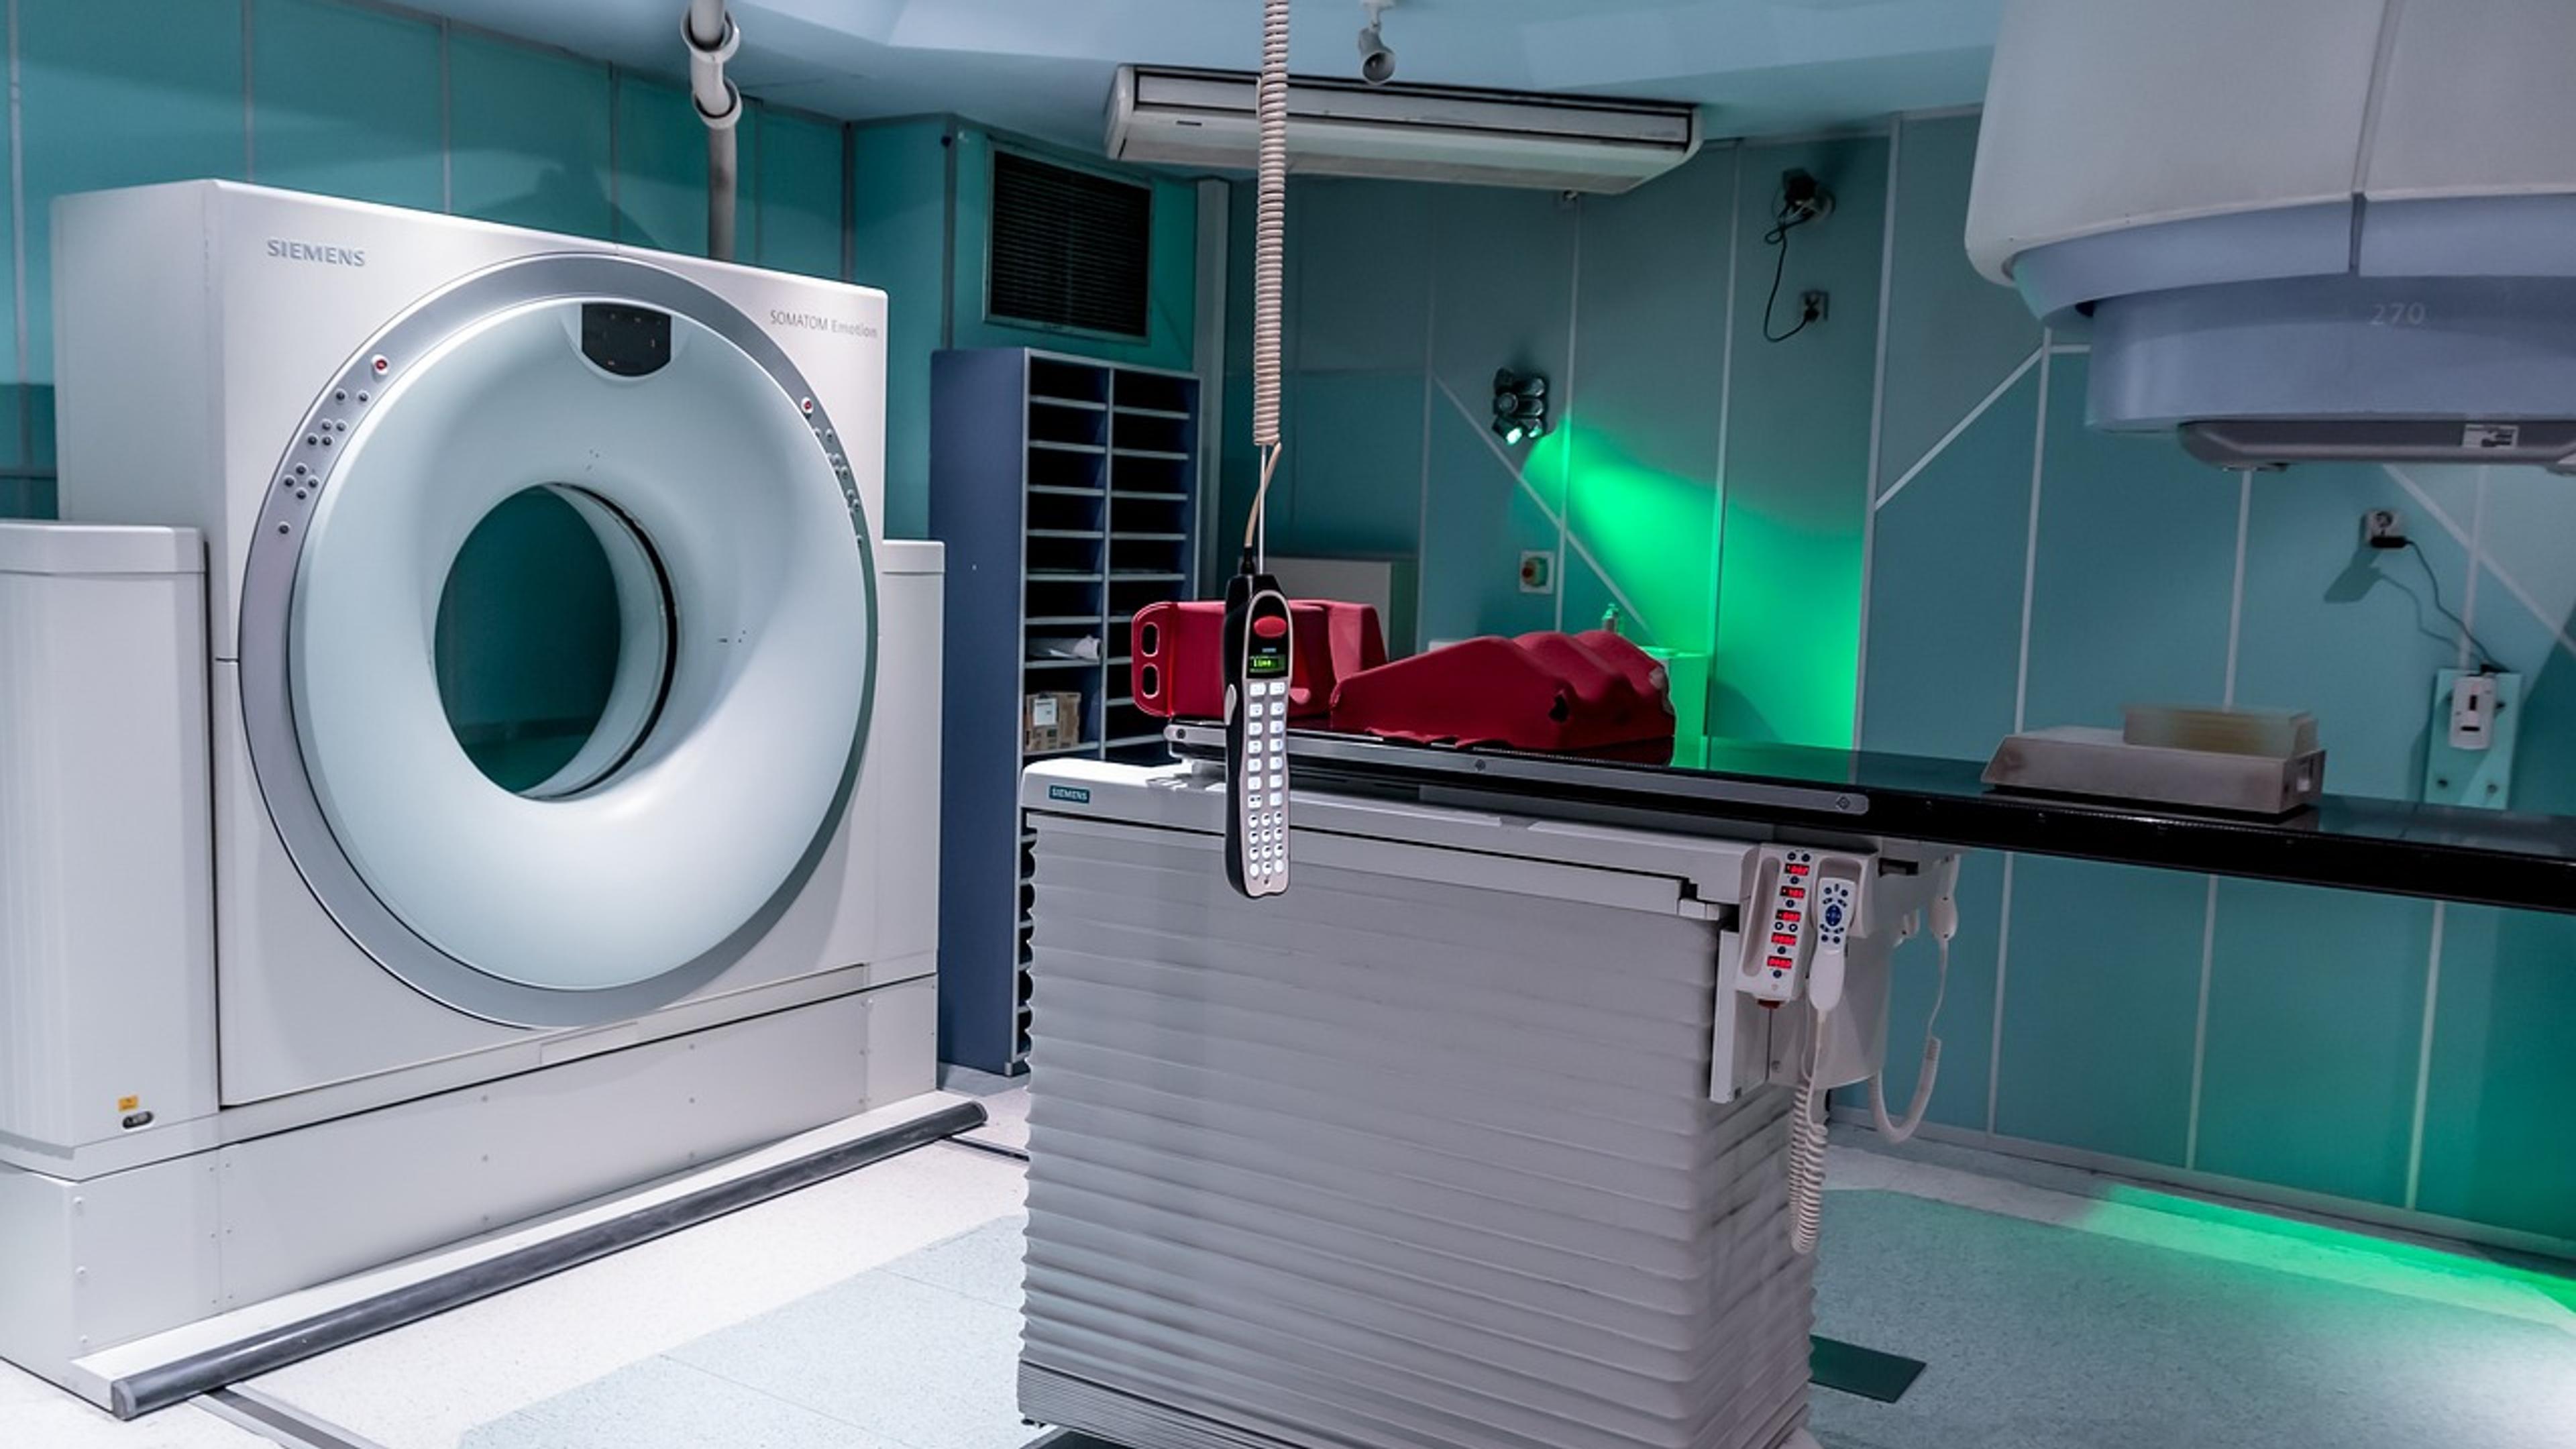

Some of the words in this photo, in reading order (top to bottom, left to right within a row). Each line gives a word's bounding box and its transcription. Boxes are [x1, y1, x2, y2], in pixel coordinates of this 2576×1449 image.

[267, 239, 365, 266] SIEMENS
[771, 310, 828, 330] SOMATOM
[831, 320, 877, 337] Emotion
[2370, 303, 2425, 325] 270
